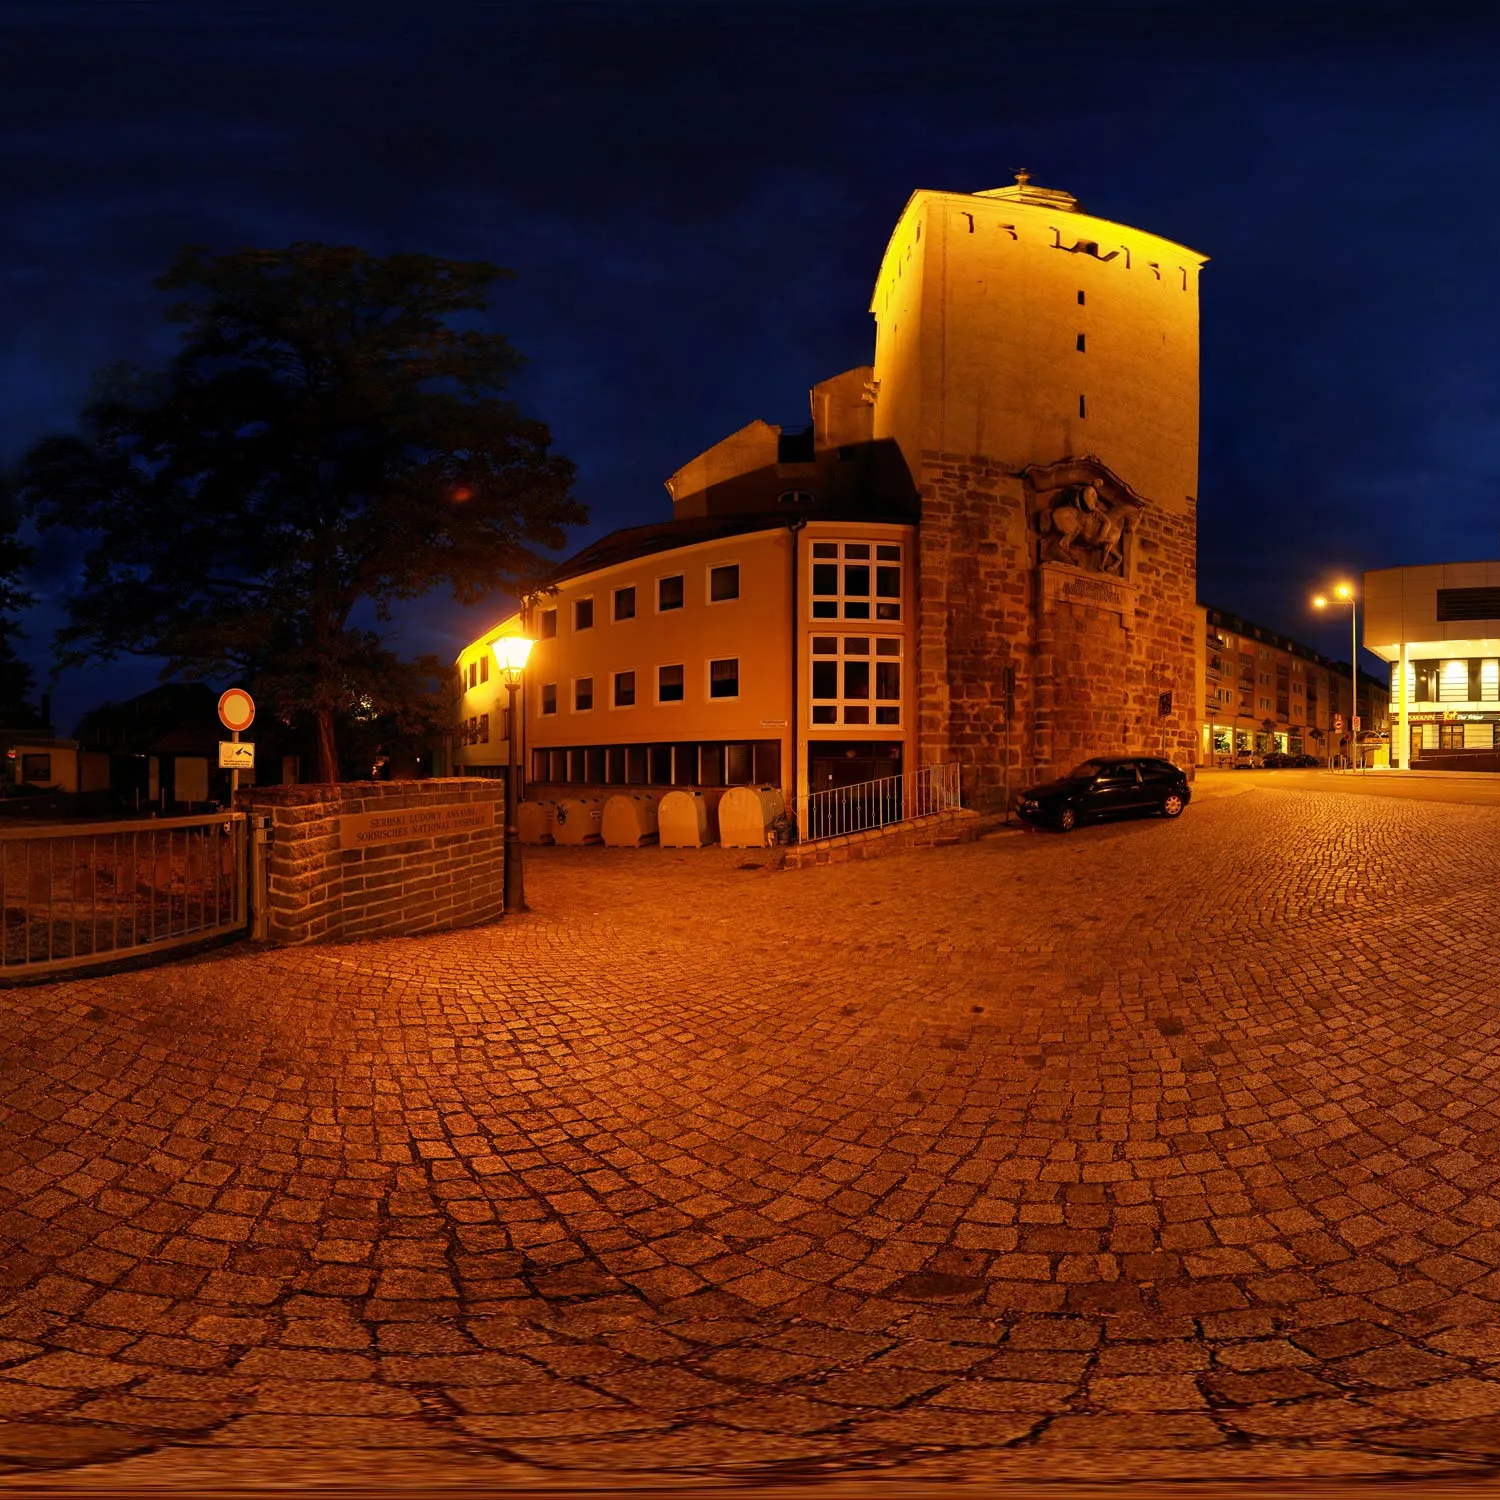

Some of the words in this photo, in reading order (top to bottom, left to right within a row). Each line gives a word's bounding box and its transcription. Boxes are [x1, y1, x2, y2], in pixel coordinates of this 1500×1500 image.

[370, 815, 406, 828] SERBSKI
[409, 811, 442, 824] LUDOWY
[446, 807, 476, 819] ANSAMBL
[356, 826, 408, 842] SORBISCHES
